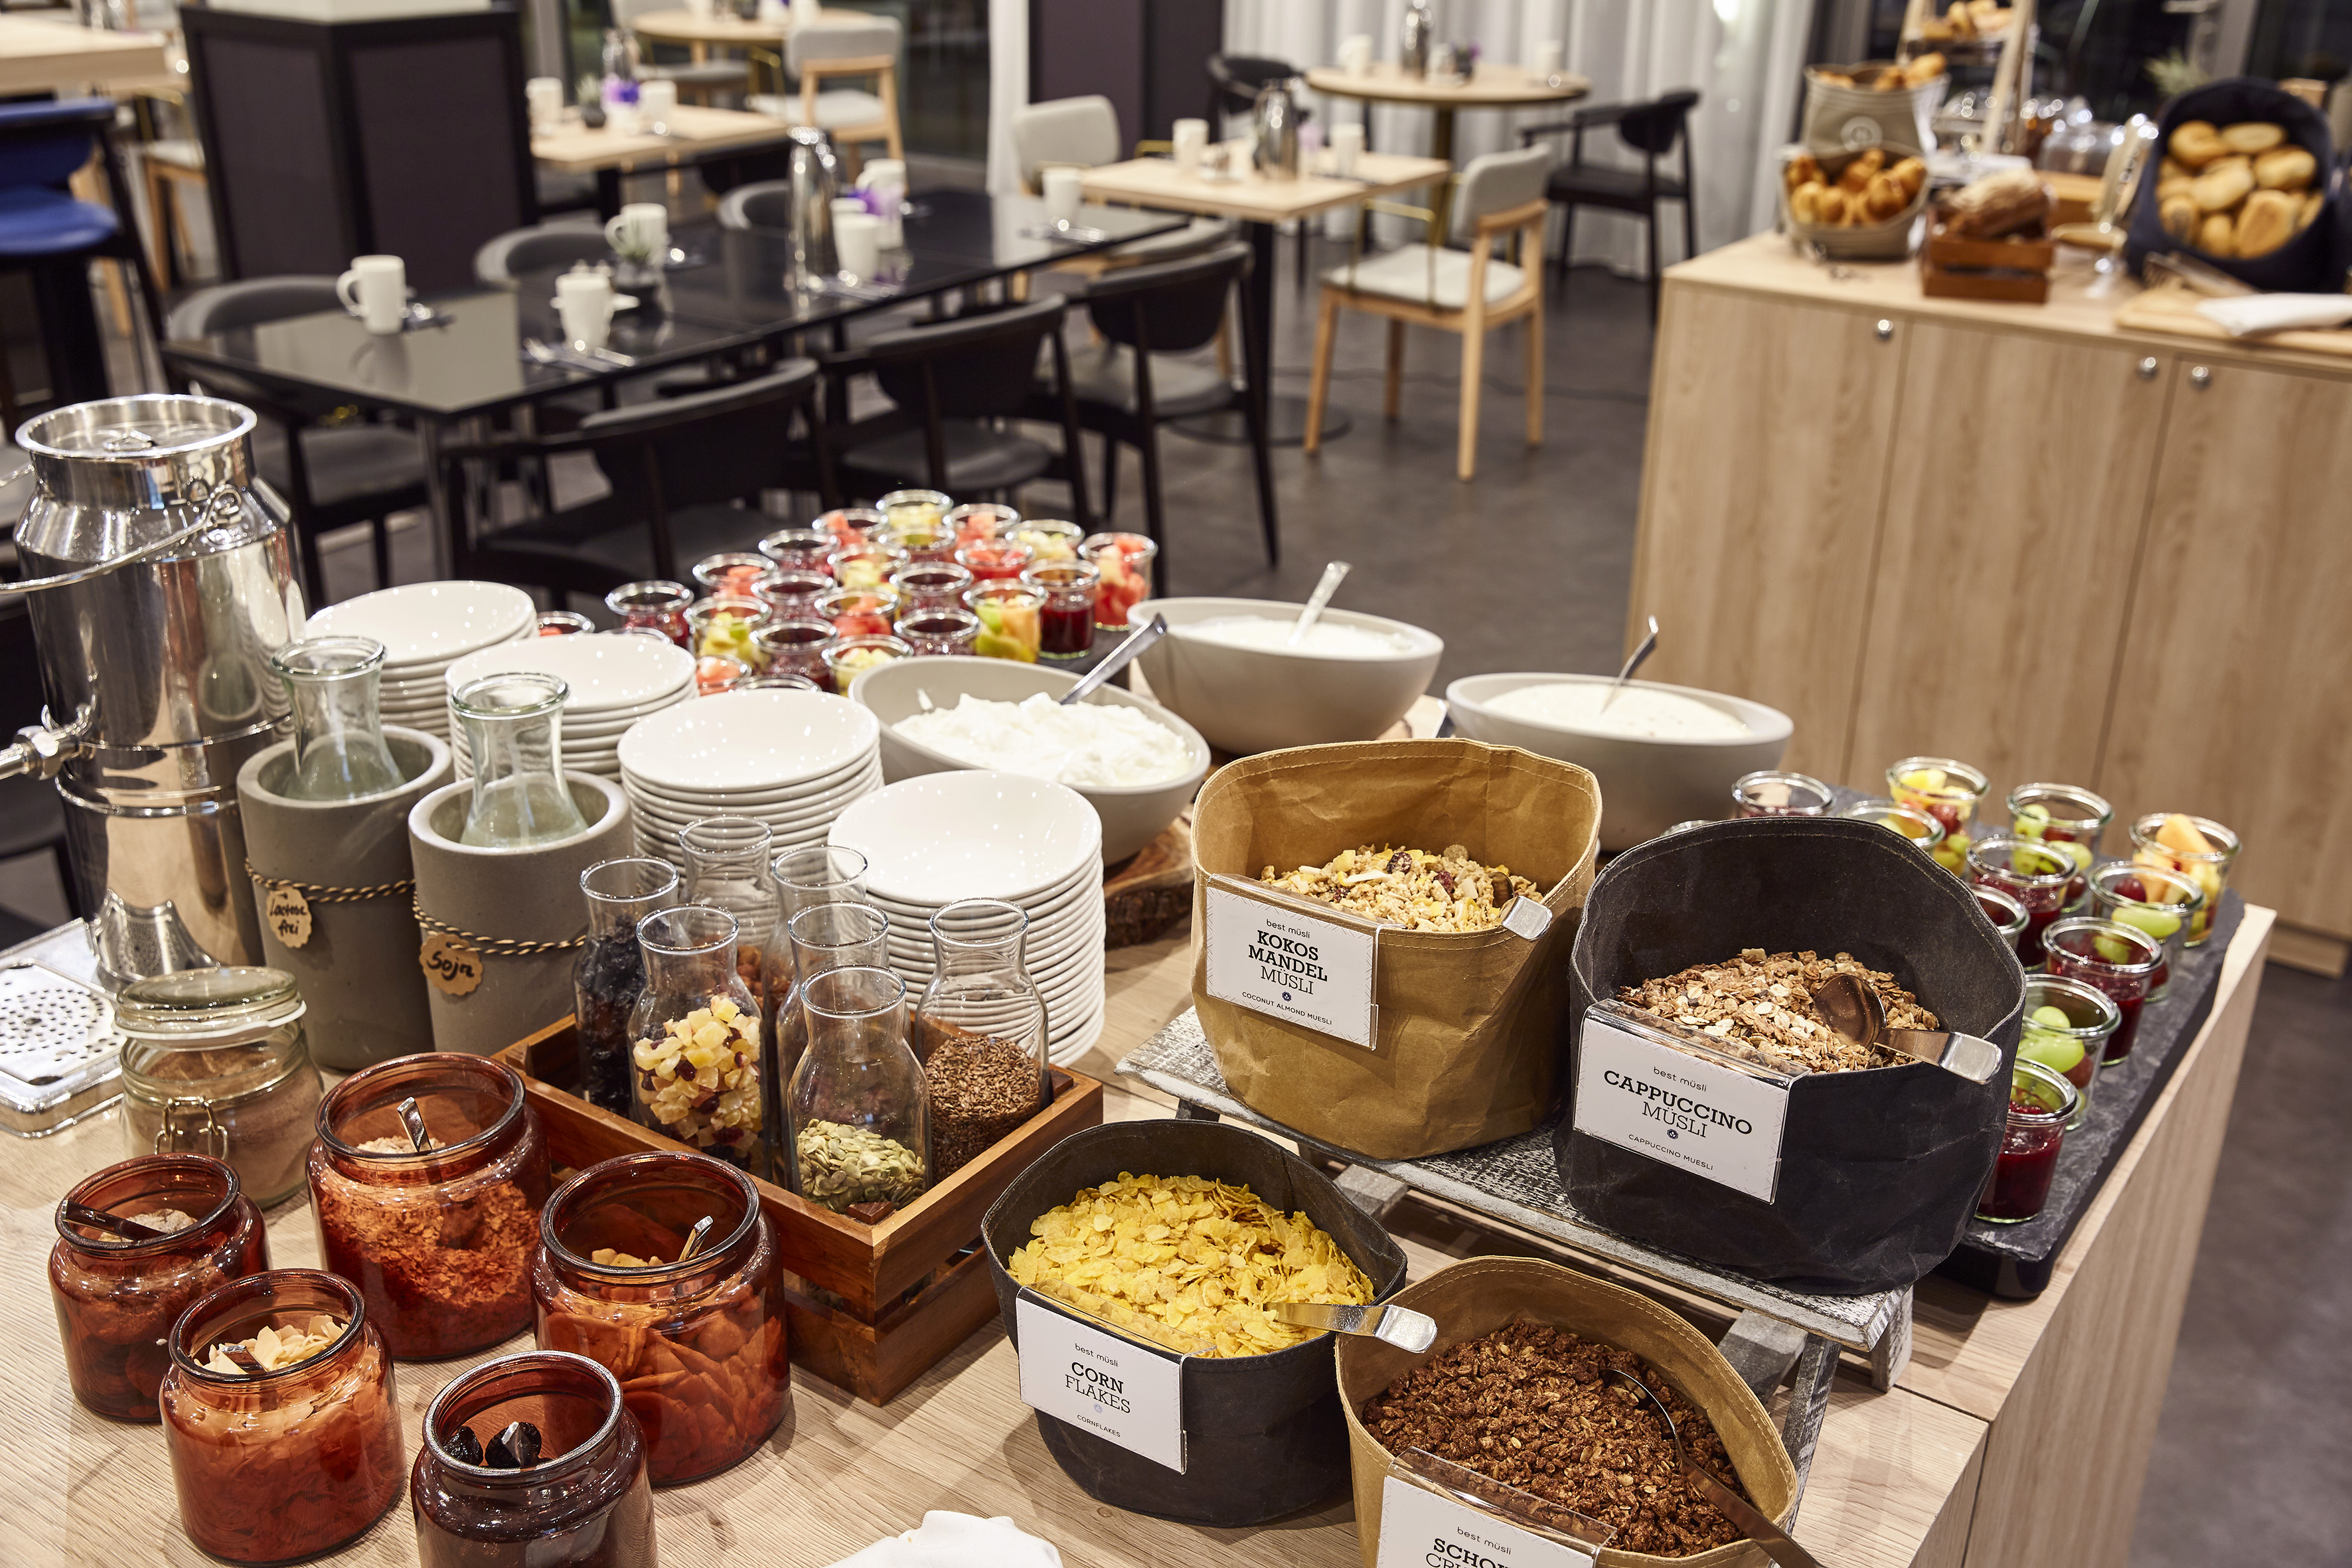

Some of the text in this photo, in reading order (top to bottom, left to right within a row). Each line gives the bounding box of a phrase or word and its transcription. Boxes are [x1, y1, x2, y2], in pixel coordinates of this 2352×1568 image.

[277, 919, 299, 937] frei
[1266, 919, 1310, 939] best müsli
[1257, 929, 1318, 961] KOKOS
[426, 950, 475, 981] Soja
[1248, 944, 1328, 982] MANDEL
[1261, 965, 1314, 995] MÜSLI
[1242, 991, 1332, 1026] COCONUT ALMOND MUESLI
[1653, 1066, 1707, 1092] best müsli
[1604, 1069, 1753, 1135] CAPPUCCINO
[1642, 1101, 1707, 1138] MÜSLI
[1628, 1134, 1713, 1171] CAPPUCCINO MUESLI
[1075, 1343, 1119, 1368] best müsli
[1065, 1373, 1131, 1414] FLAKES
[1071, 1362, 1124, 1395] CORN
[1077, 1414, 1121, 1438] CORNFLAKES
[1457, 1526, 1512, 1555] best müsli
